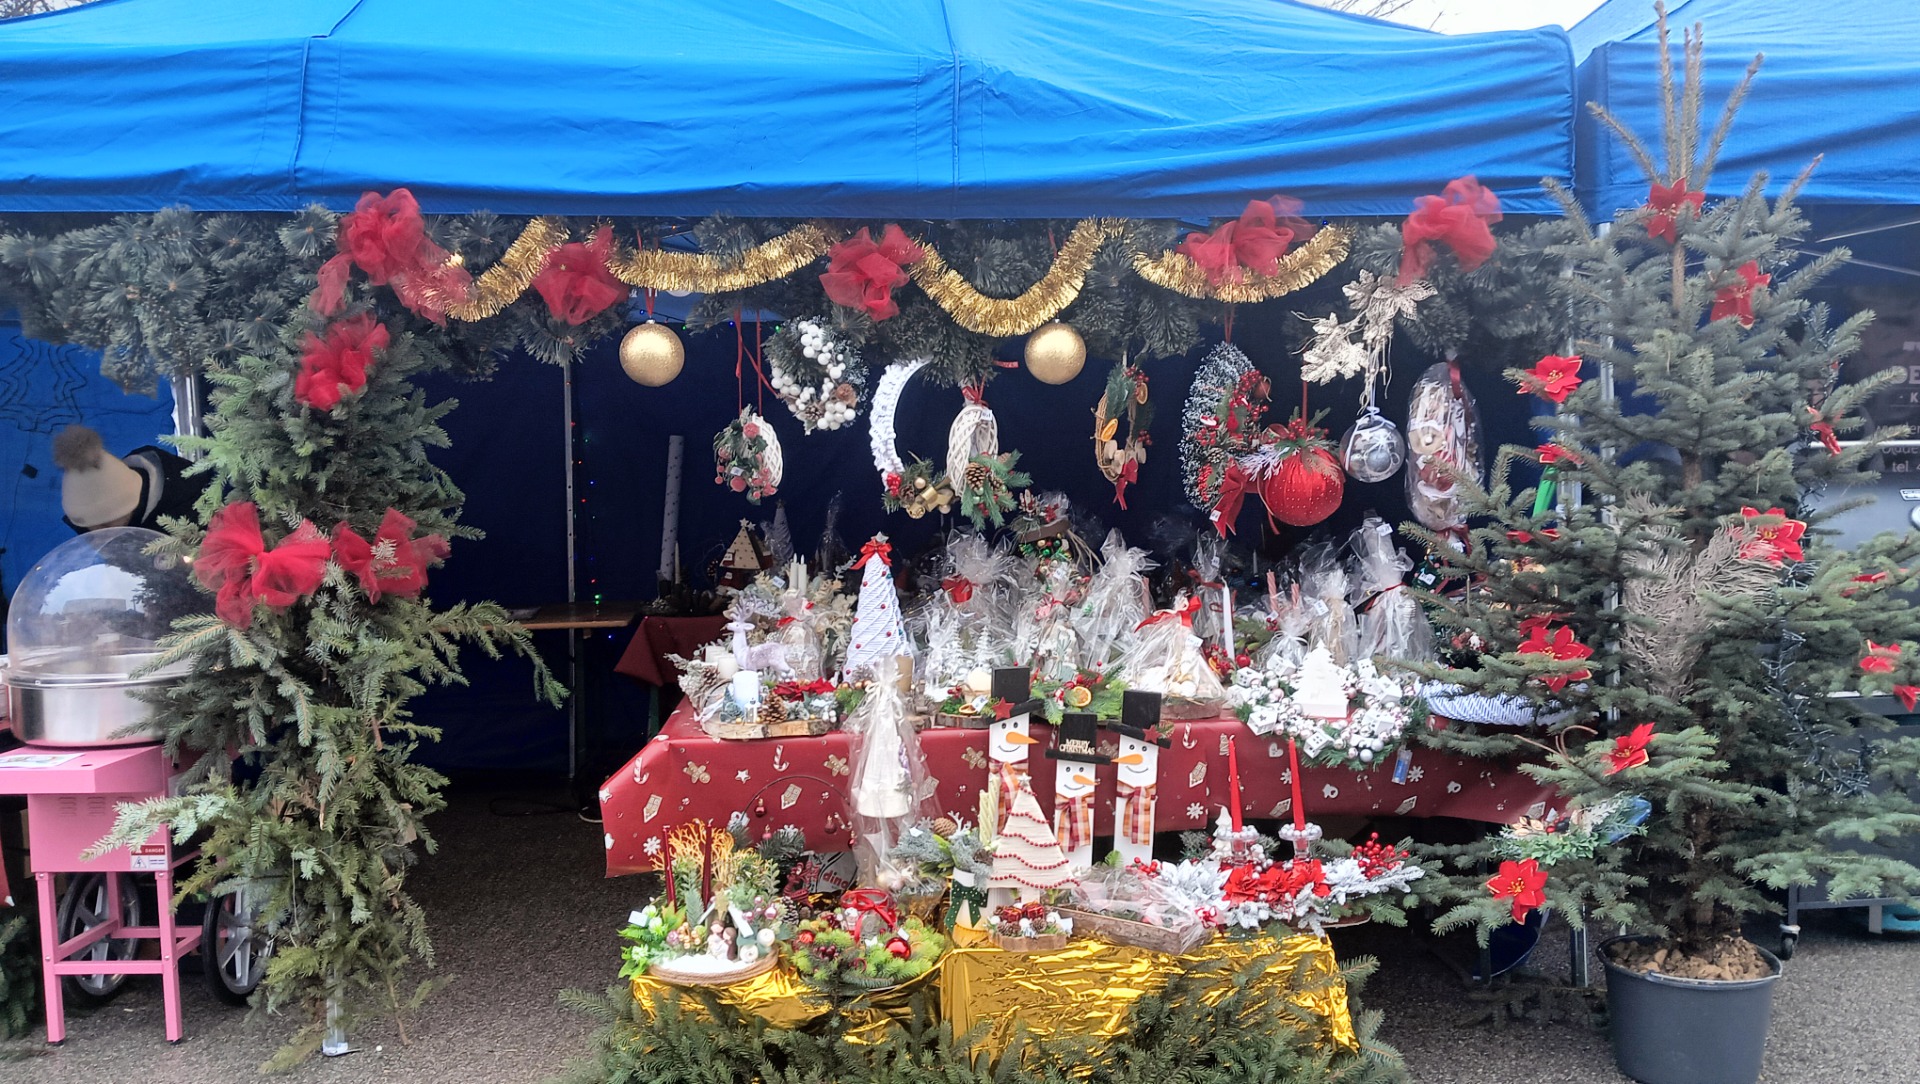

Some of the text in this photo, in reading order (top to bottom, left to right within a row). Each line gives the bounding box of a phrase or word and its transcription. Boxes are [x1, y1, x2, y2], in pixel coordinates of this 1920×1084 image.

[1059, 743, 1095, 755] CHRISTMAS
[1066, 738, 1091, 748] MERRY
[823, 870, 850, 889] dino
